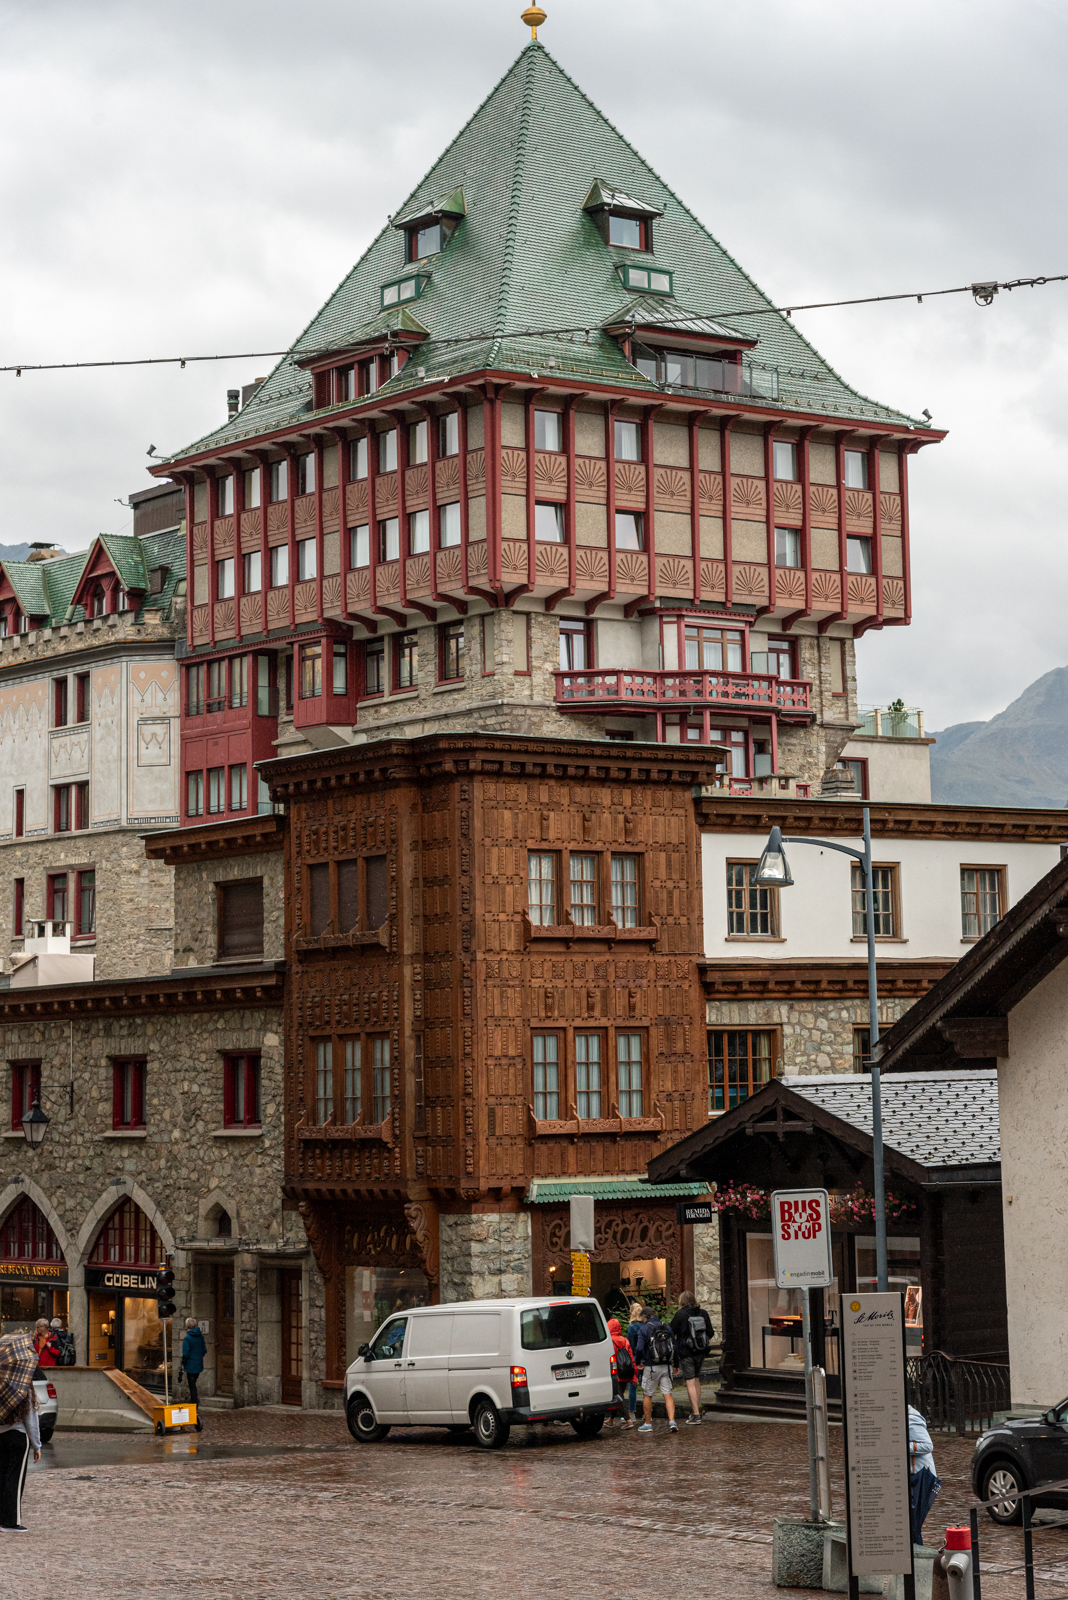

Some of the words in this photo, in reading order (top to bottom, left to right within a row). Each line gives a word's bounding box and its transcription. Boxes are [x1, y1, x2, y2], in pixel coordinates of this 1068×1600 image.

[780, 1199, 821, 1223] BUS
[781, 1222, 822, 1240] STOP
[32, 1266, 60, 1277] ARDESSI
